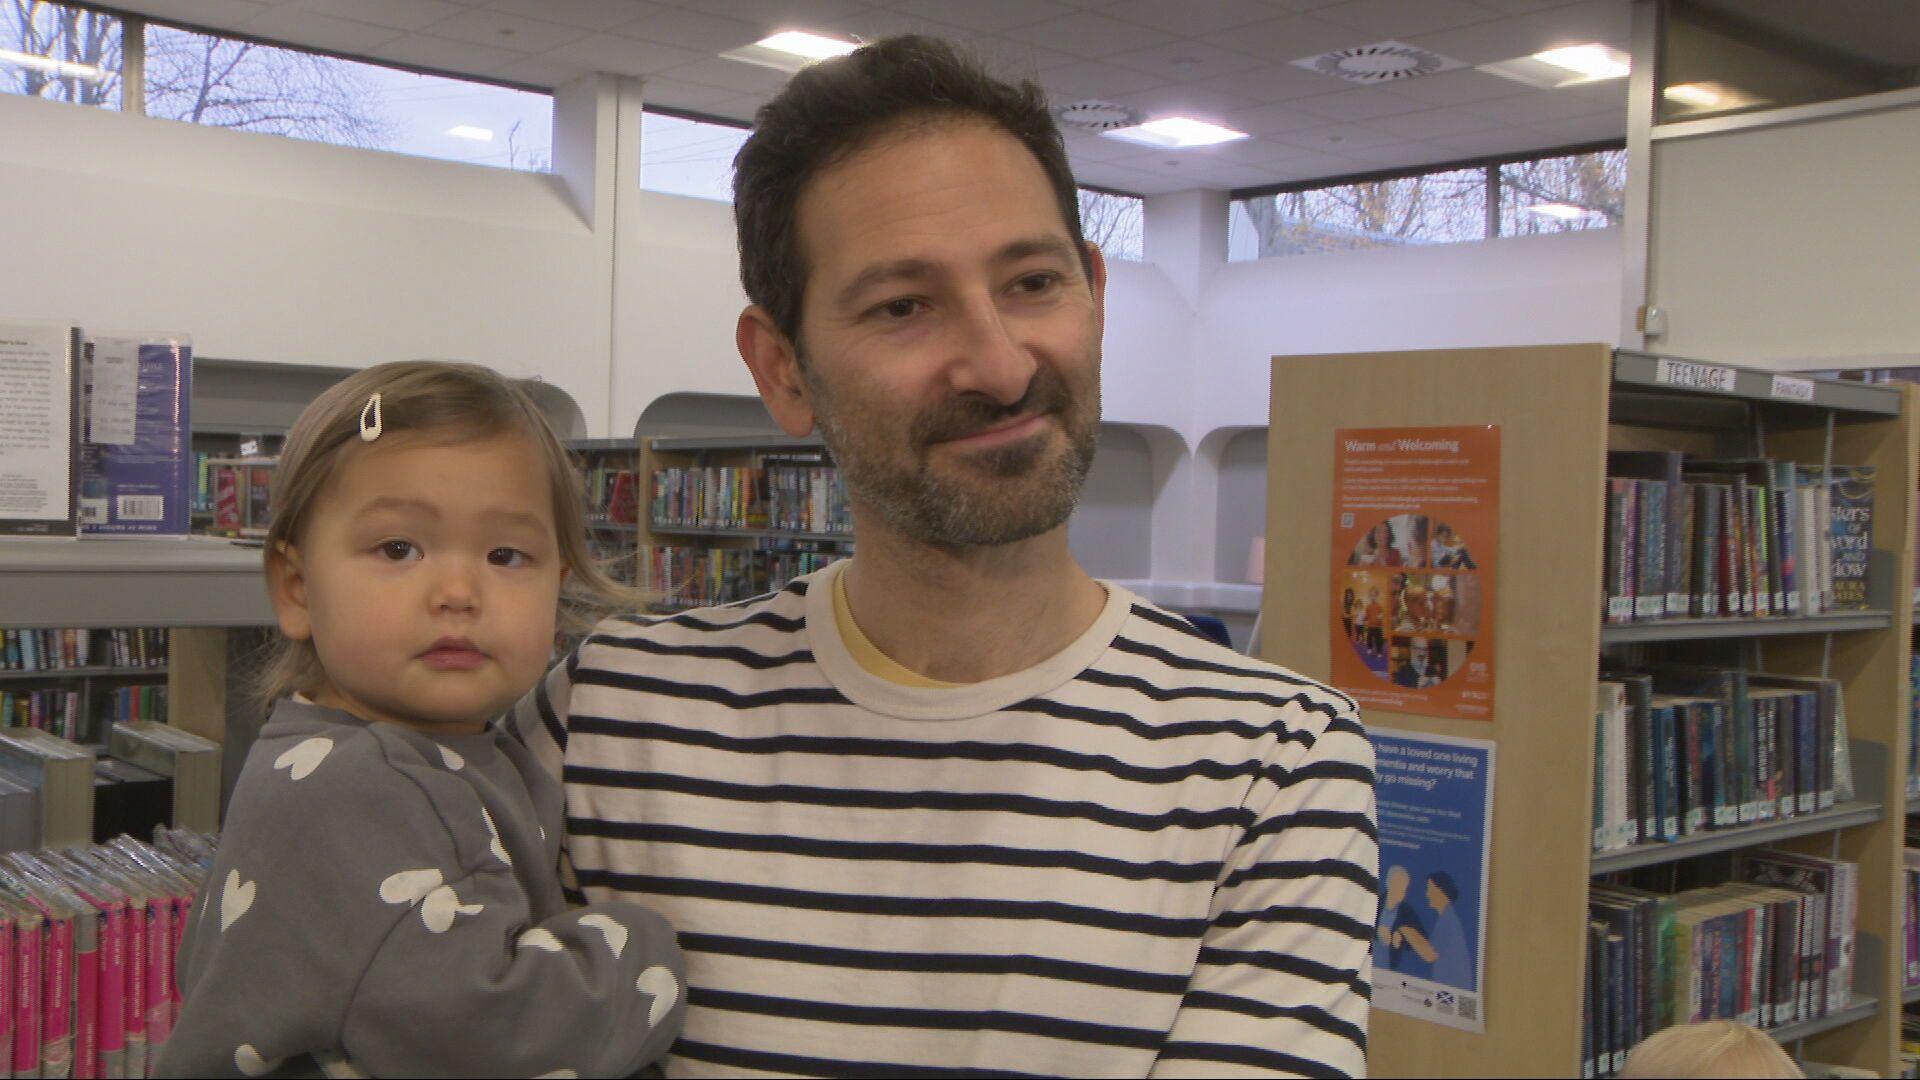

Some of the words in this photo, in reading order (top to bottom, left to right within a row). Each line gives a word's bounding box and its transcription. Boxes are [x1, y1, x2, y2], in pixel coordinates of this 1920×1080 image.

[1666, 362, 1727, 390] TEENAGE
[1345, 440, 1376, 451] Warm
[1398, 438, 1460, 453] Welcoming
[1378, 743, 1400, 754] have
[1407, 745, 1432, 758] loved
[1433, 751, 1451, 761] one
[1451, 752, 1478, 768] living
[1407, 762, 1426, 772] and
[1426, 767, 1454, 779] worry
[1454, 767, 1474, 779] that
[1384, 774, 1398, 784] go
[1398, 775, 1437, 791] missing?
